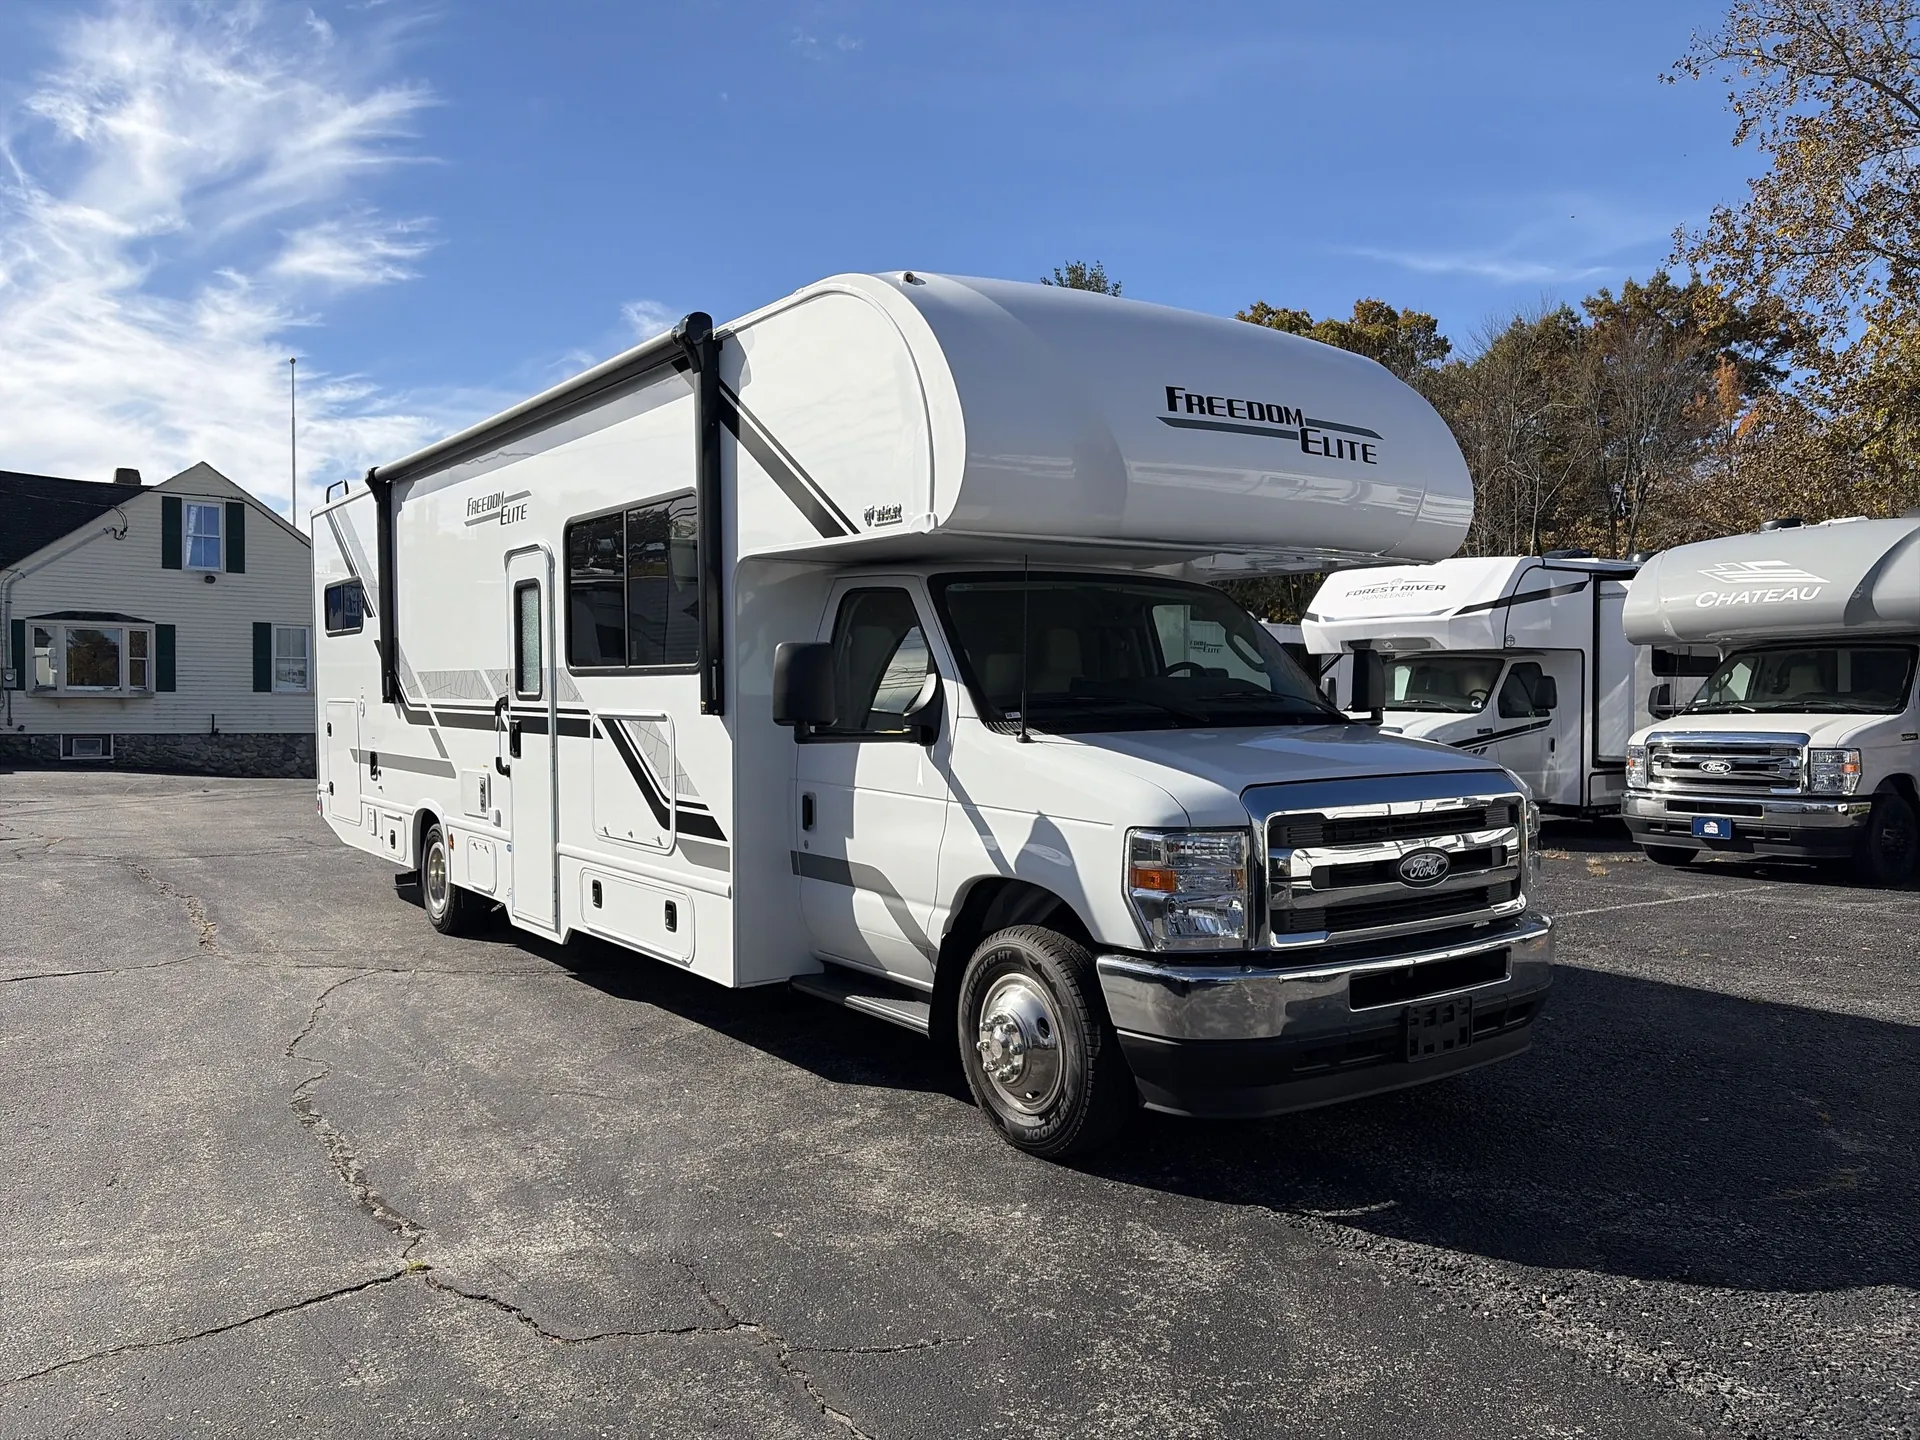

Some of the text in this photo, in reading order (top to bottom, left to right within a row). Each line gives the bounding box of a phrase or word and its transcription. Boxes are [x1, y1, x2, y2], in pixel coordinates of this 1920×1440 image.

[1164, 385, 1304, 427] FREEDOM
[1300, 427, 1378, 465] ELITE
[466, 490, 504, 517] FREEDOM
[500, 503, 528, 526] ELITE
[1345, 584, 1446, 598] FOREST RIVER
[1695, 586, 1822, 608] CHATEAU
[1409, 858, 1440, 878] Ford
[997, 950, 1013, 961] HT
